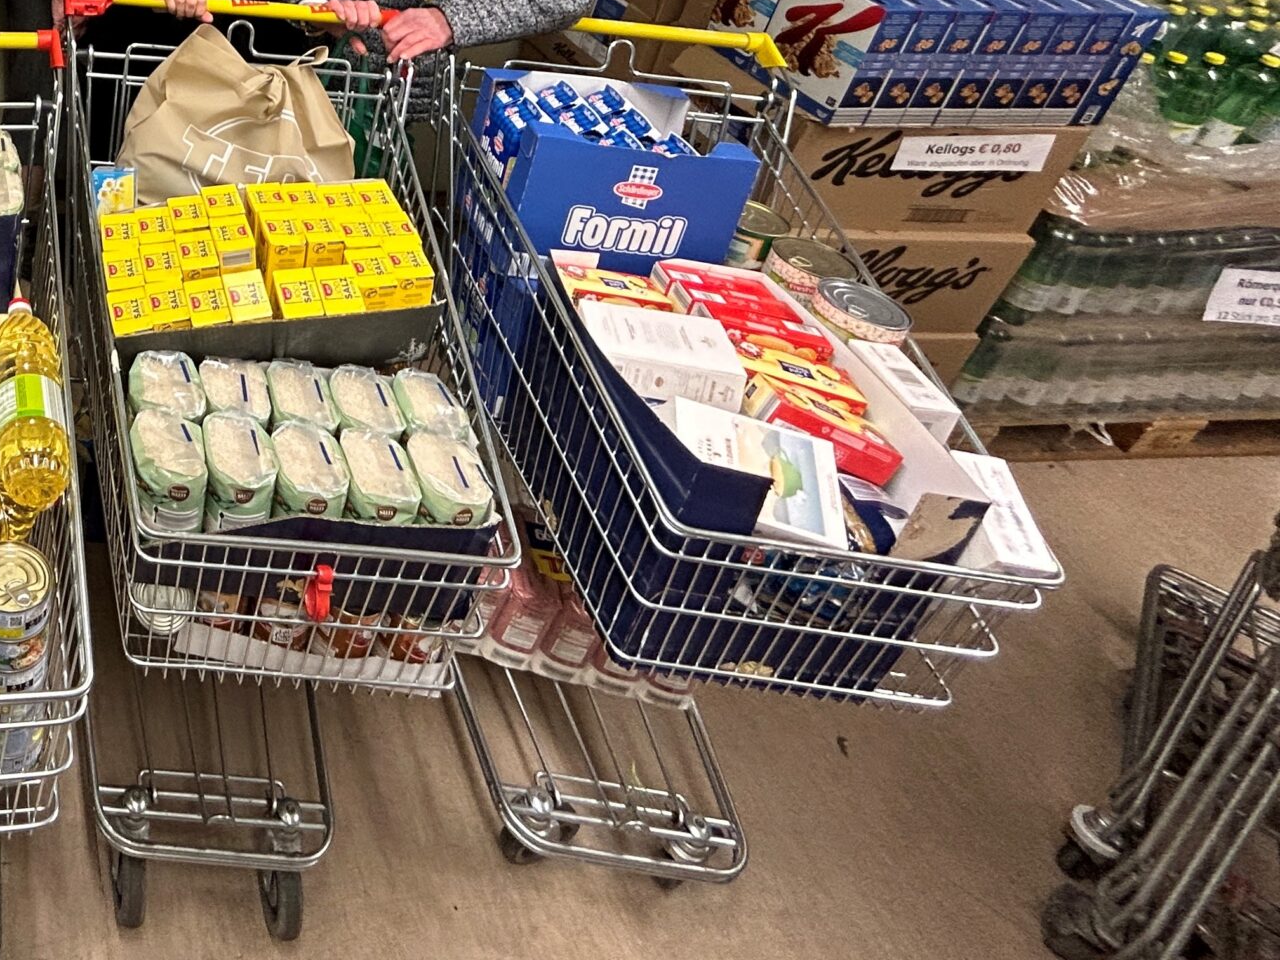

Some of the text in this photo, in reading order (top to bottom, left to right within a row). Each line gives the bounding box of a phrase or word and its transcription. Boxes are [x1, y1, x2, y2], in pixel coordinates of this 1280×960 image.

[925, 144, 976, 157] Kellogs
[990, 142, 1022, 156] 0,80
[562, 206, 687, 256] Formil
